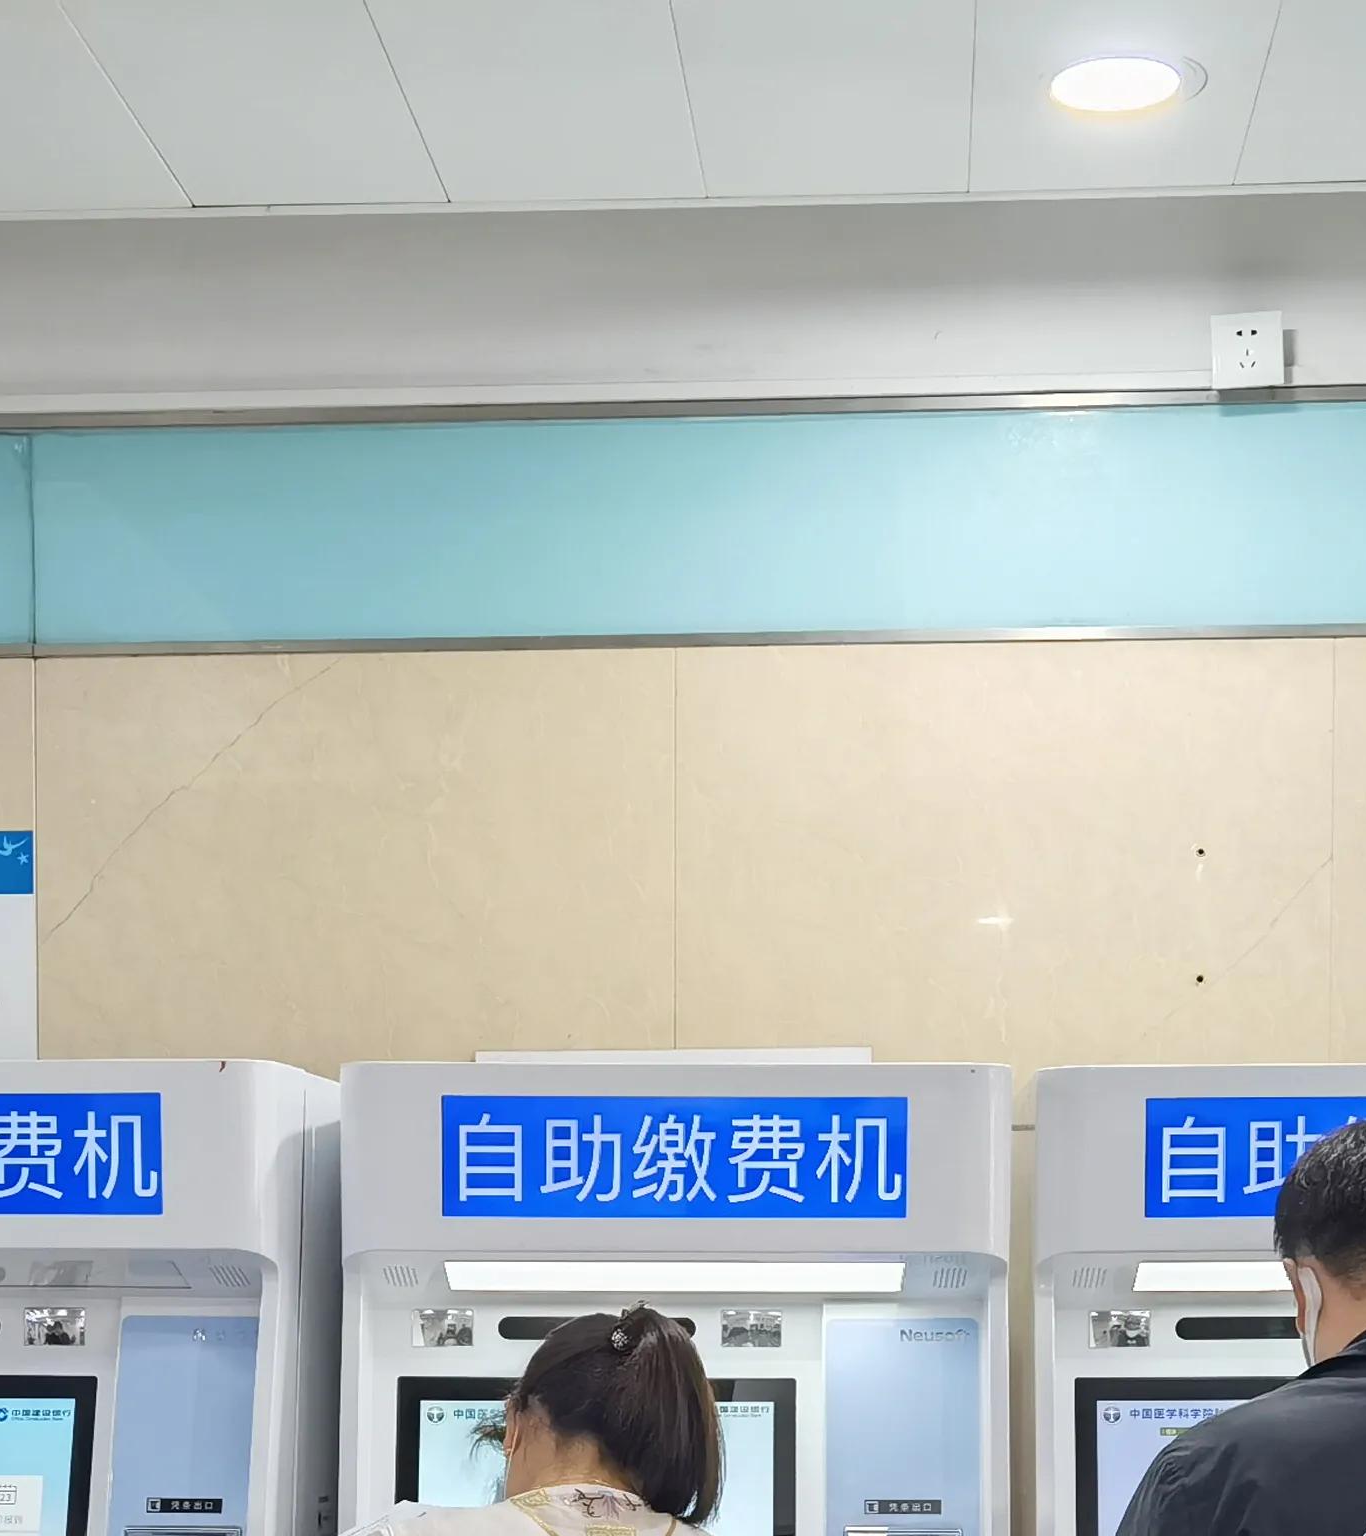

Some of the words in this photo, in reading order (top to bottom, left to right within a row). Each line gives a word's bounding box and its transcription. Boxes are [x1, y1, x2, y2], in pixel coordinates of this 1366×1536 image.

[458, 1112, 903, 1204] 自助缴费机
